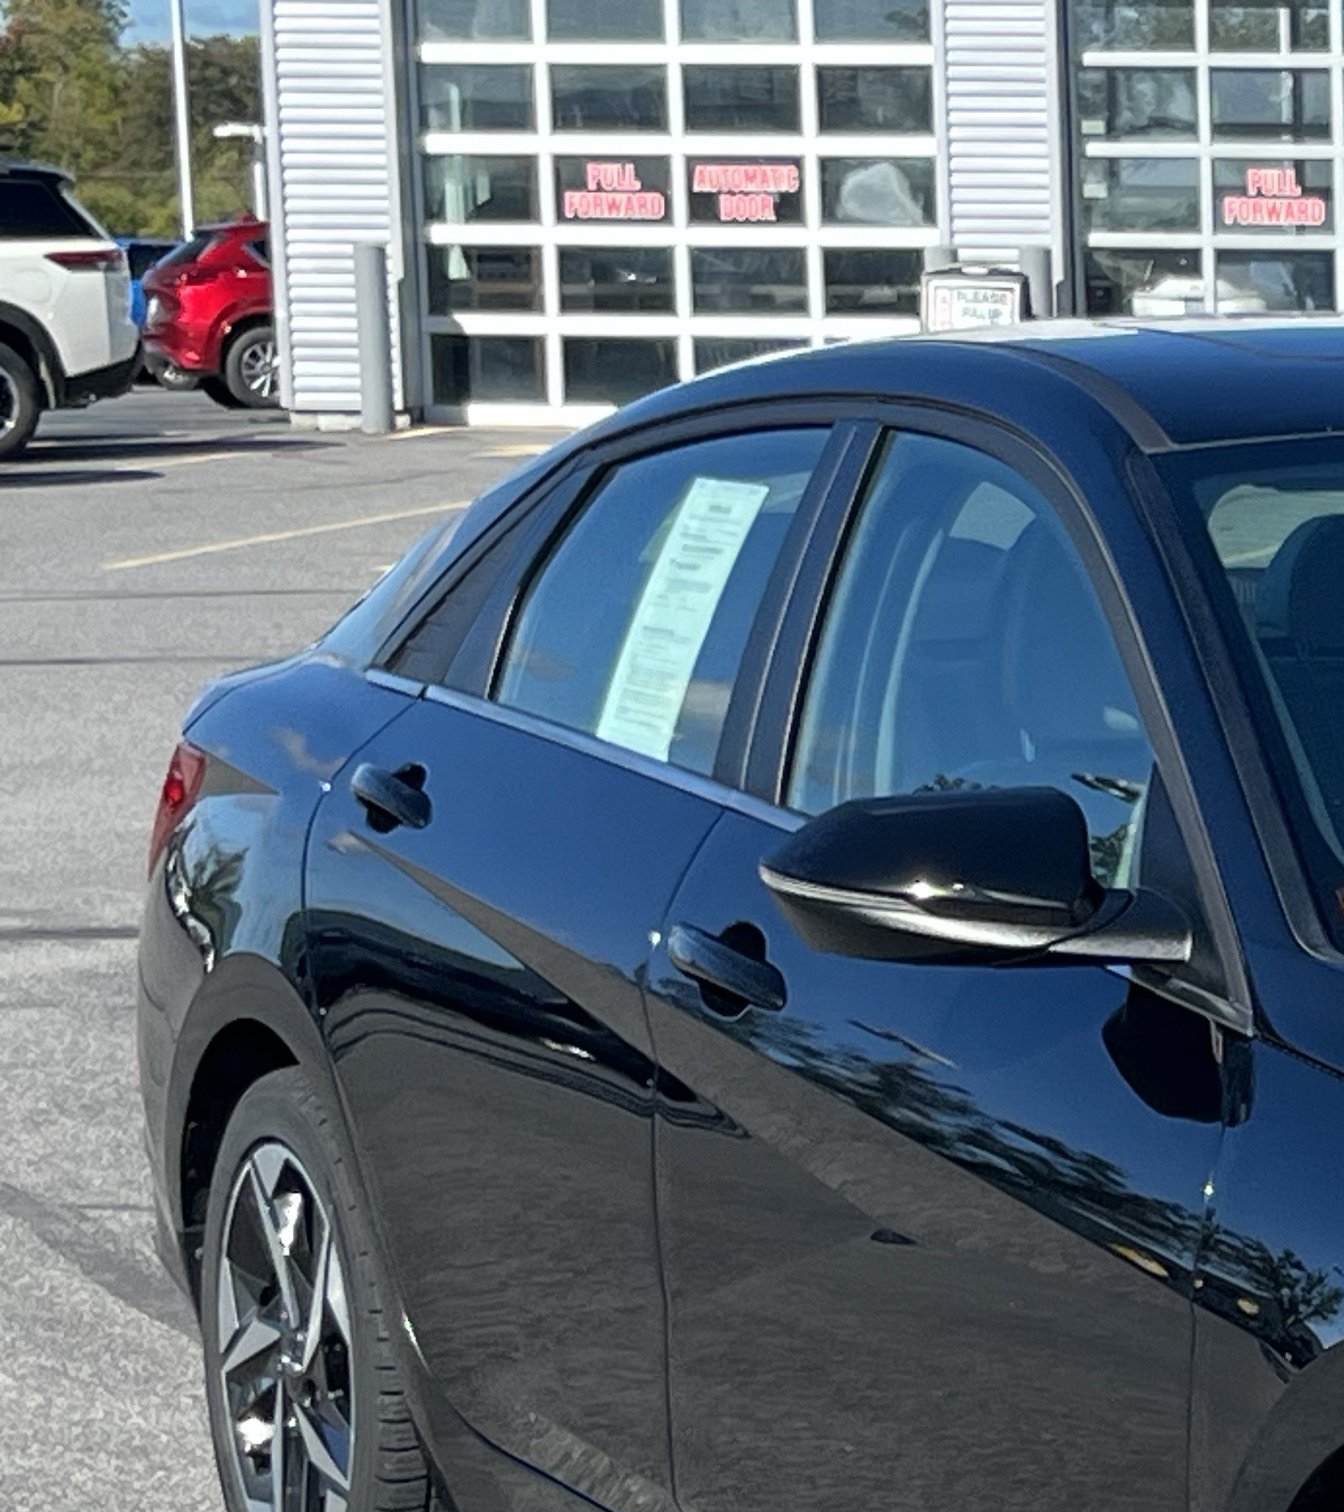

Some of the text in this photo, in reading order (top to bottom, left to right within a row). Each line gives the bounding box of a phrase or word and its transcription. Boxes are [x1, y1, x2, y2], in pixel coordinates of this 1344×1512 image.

[586, 162, 641, 191] PULL
[693, 164, 799, 193] AUTOMATIC
[1247, 168, 1301, 197] PULL
[565, 192, 665, 220] FORWARD
[719, 194, 777, 221] DOOR
[1224, 198, 1326, 226] FORWARD
